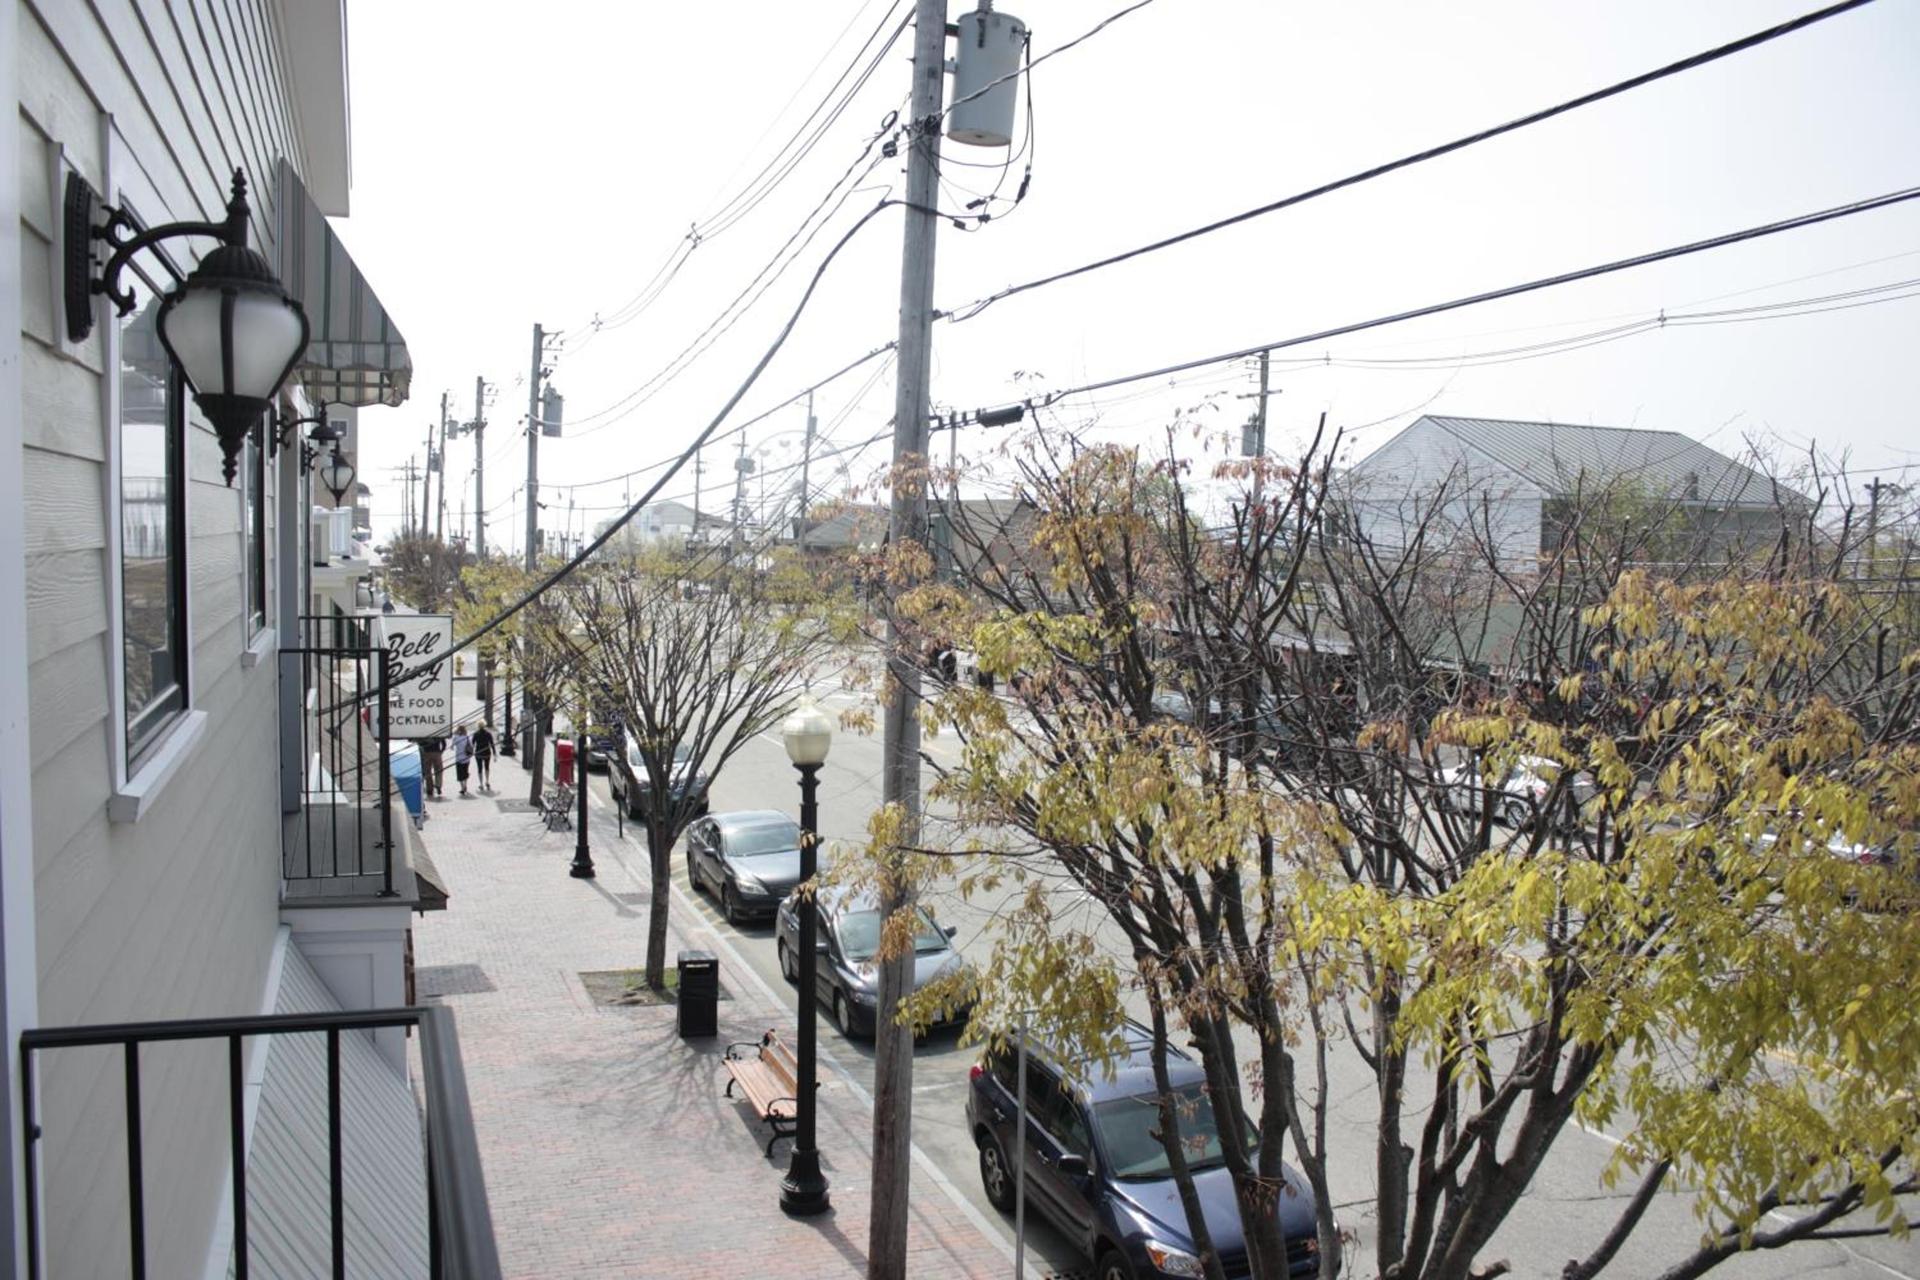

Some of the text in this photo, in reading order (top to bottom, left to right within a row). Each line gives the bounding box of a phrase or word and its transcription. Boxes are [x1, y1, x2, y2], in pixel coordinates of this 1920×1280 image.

[388, 632, 441, 662] Bell
[408, 698, 445, 708] FOOD
[380, 714, 446, 726] OCKTAILS
